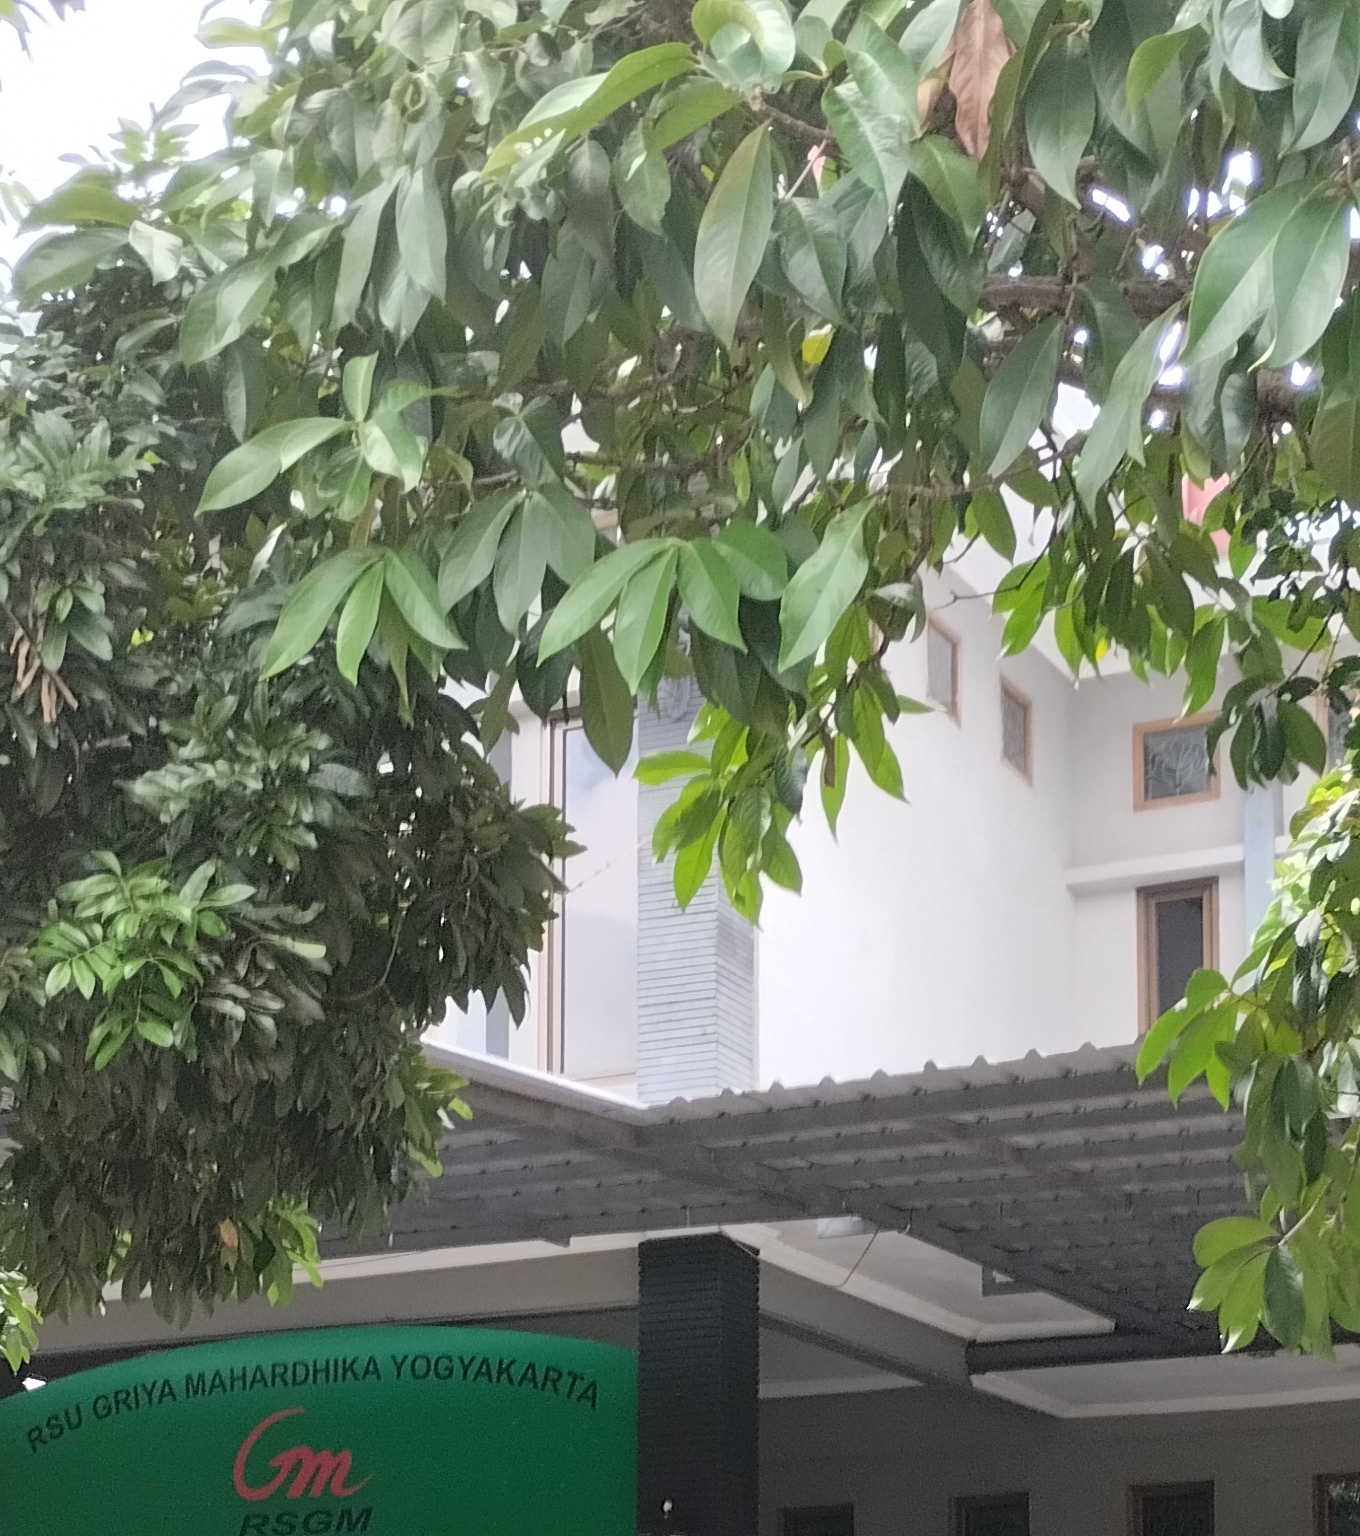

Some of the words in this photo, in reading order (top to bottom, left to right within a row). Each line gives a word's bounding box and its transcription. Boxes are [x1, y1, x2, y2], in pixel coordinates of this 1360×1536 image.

[26, 1403, 83, 1453] RSU
[92, 1378, 177, 1420] GRIYA
[184, 1355, 382, 1399] MAHARDHIKA
[392, 1354, 598, 1409] YOGYAKARTA
